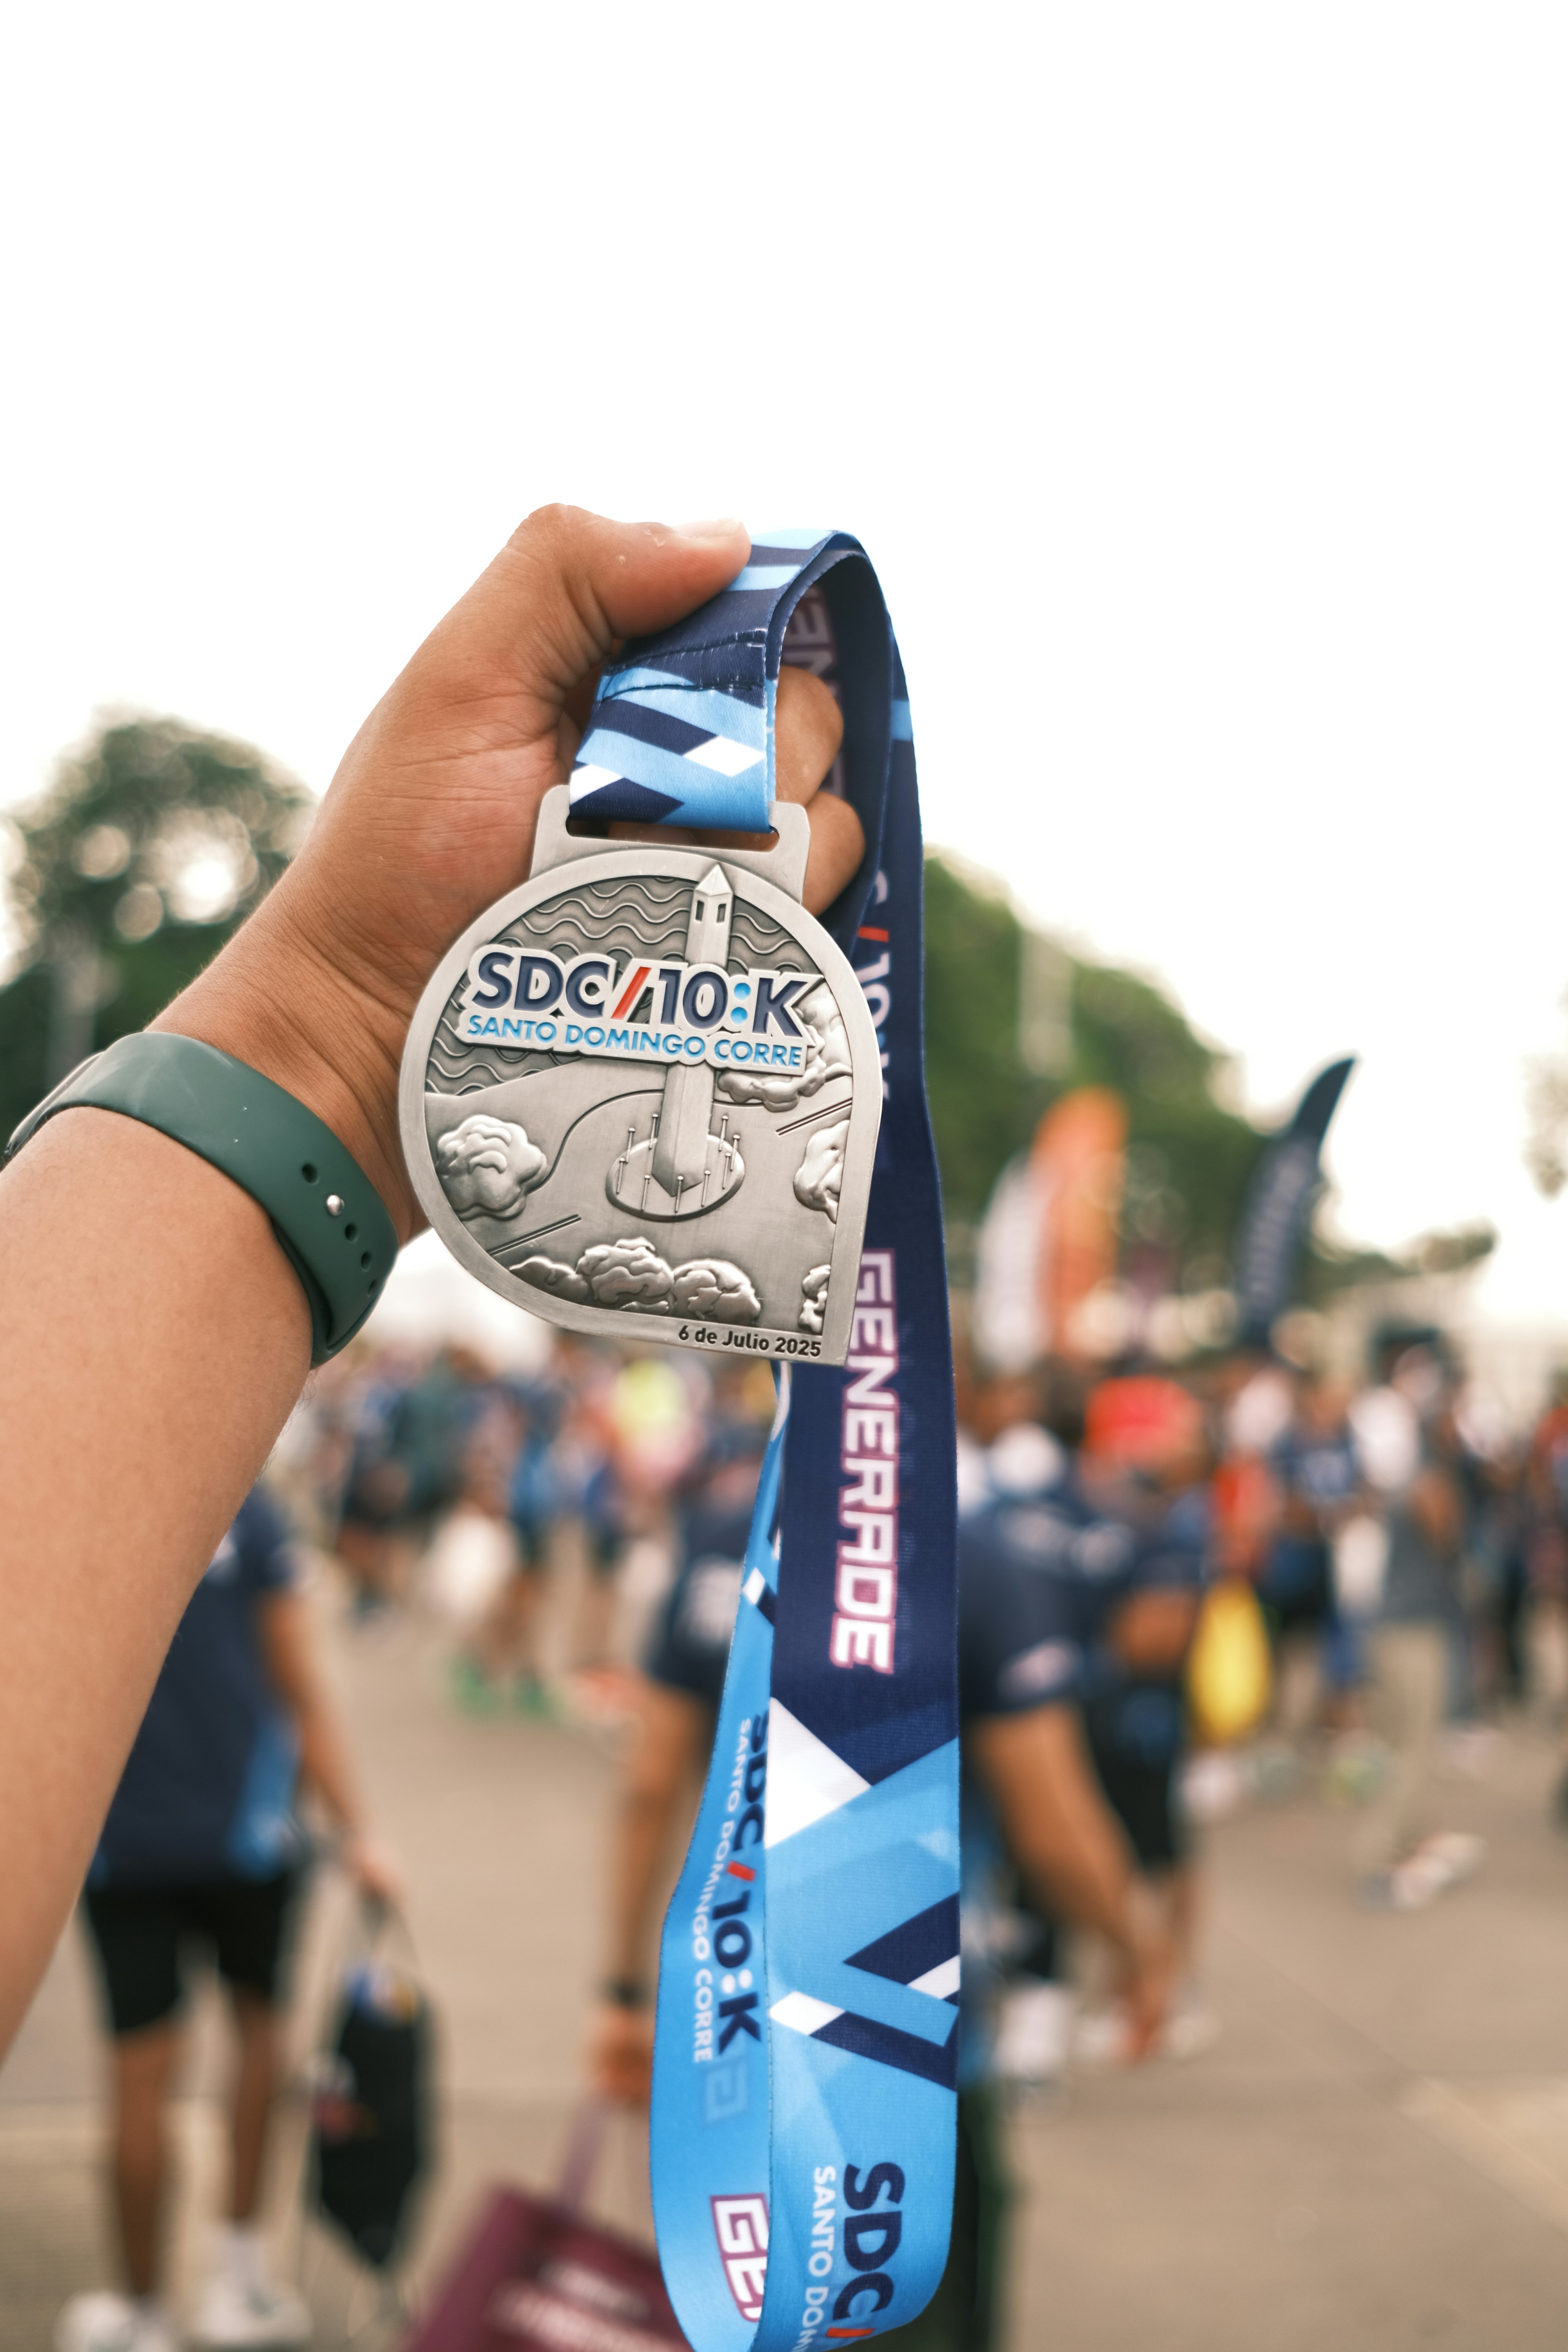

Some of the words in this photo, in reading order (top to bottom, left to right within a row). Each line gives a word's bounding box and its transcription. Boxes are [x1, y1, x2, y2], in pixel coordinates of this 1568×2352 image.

[467, 1014, 557, 1044] SANTO
[565, 1024, 706, 1058] DOMINGO
[714, 1039, 803, 1068] CORRE
[472, 951, 808, 1038] SDC/10:K
[678, 1325, 689, 1340] 6
[694, 1327, 718, 1344] de
[722, 1330, 770, 1351] Julio
[774, 1337, 822, 1357] 2025
[831, 1248, 900, 1674] GENERADE
[727, 1717, 751, 1813] SANTO
[692, 1820, 735, 1961] DOMINGO
[693, 1968, 714, 2063] CORRE
[710, 2193, 769, 2323] GE
[808, 2165, 836, 2277] SANTO
